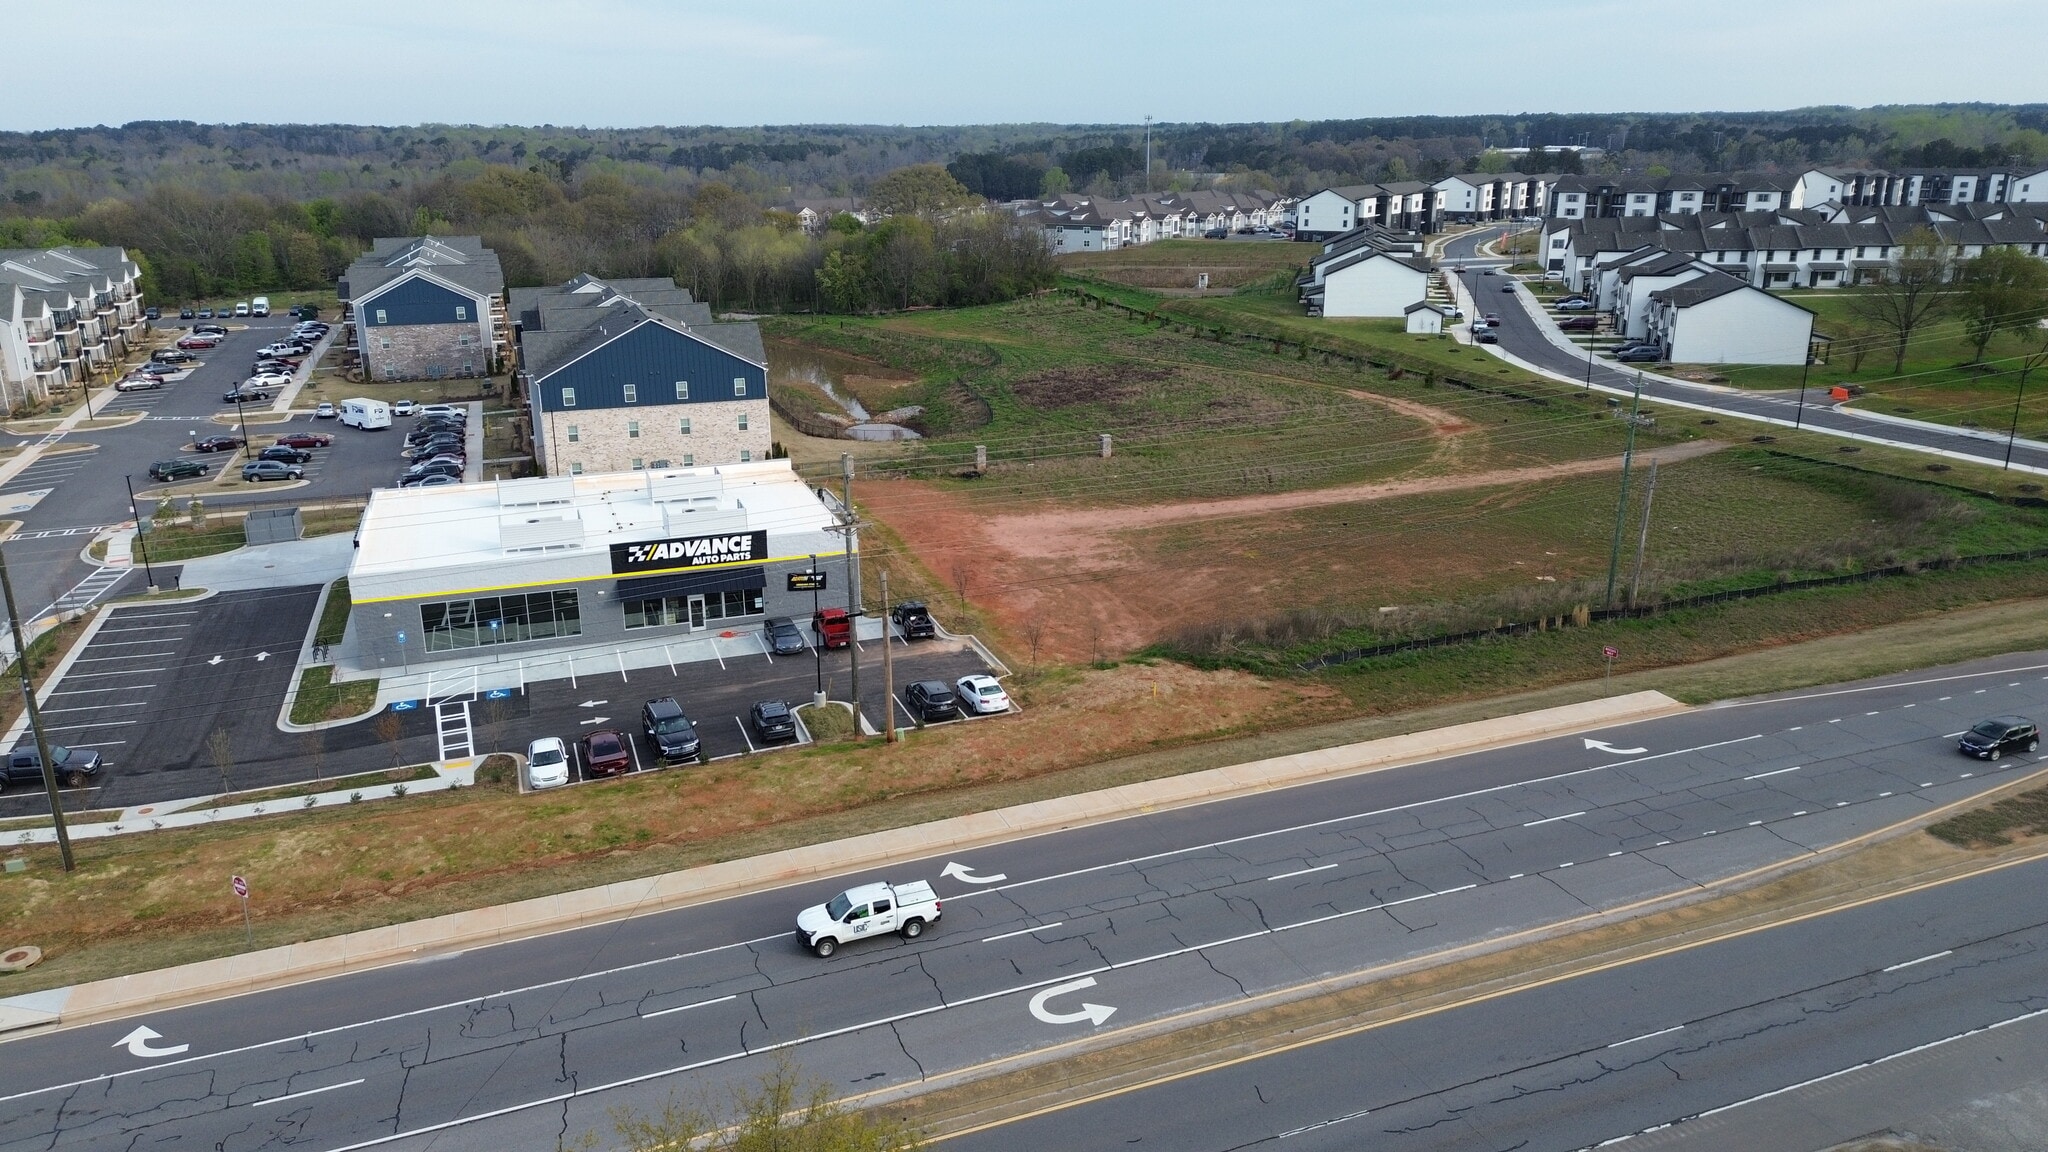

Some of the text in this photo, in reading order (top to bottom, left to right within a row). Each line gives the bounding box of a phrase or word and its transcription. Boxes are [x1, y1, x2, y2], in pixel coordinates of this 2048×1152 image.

[652, 535, 752, 560] ADVANCE
[692, 552, 751, 566] AUTO PARTS
